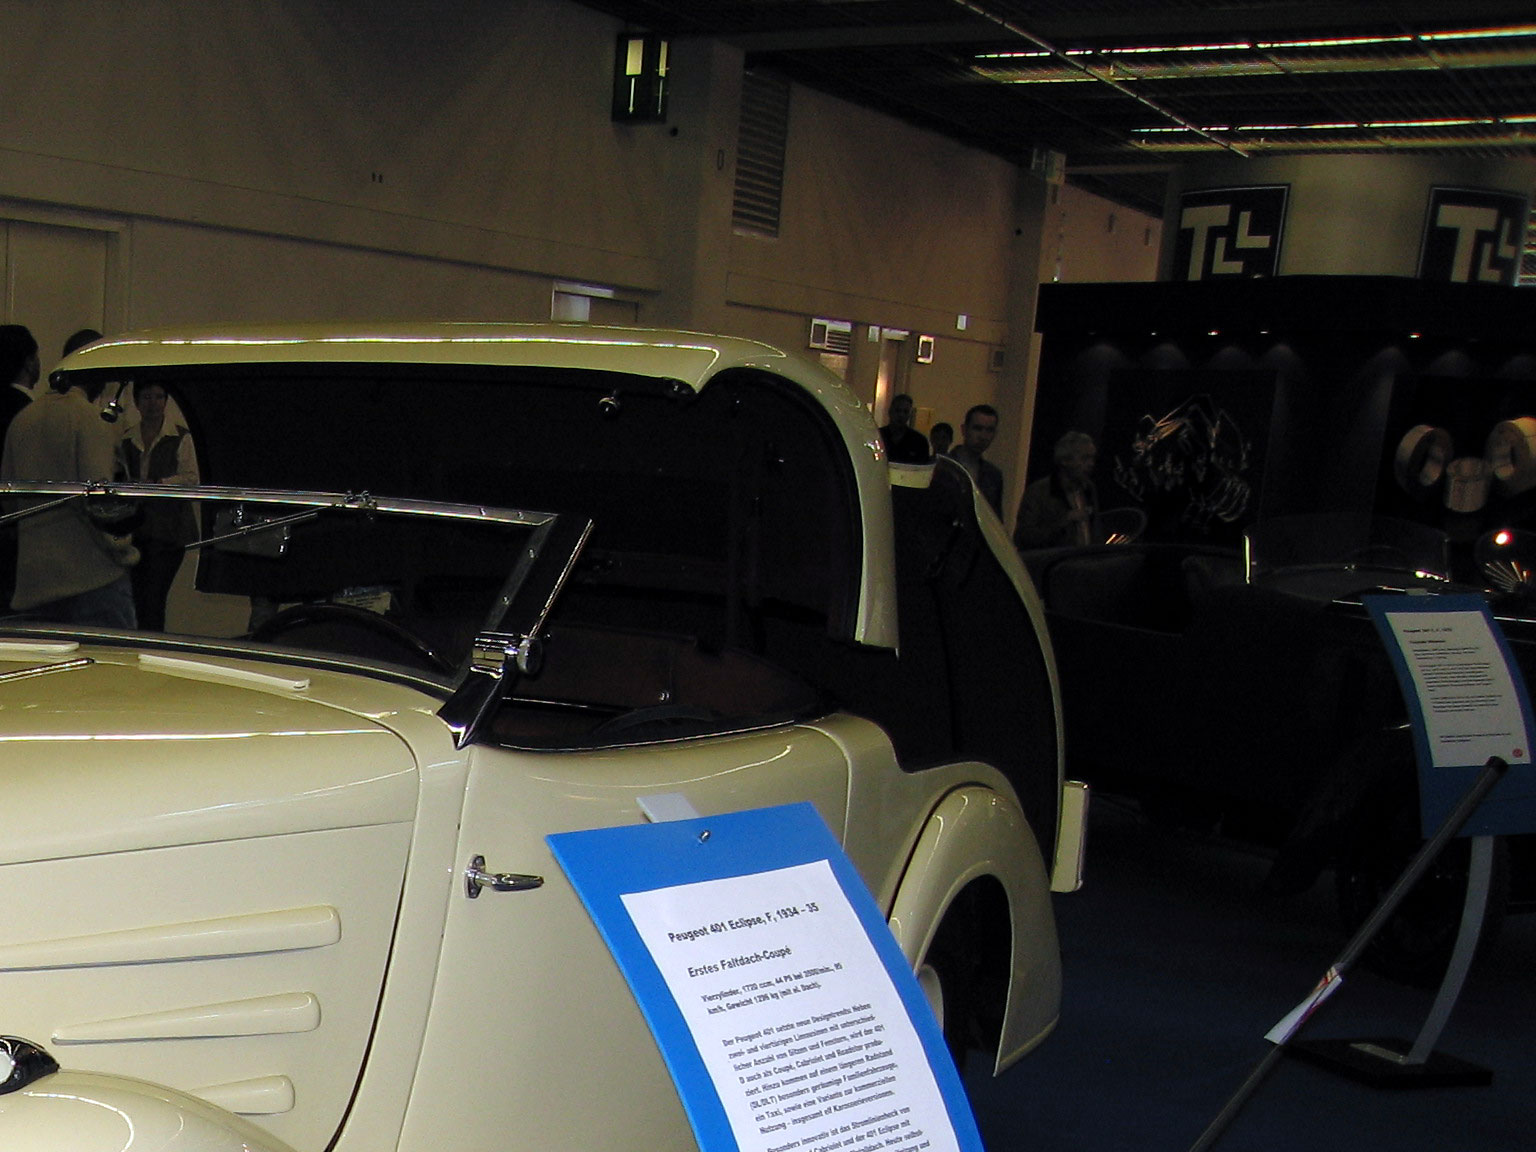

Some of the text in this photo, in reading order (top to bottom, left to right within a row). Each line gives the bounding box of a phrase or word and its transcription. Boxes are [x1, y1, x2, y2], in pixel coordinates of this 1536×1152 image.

[668, 926, 710, 942] Peugeot
[710, 922, 728, 933] 401
[728, 917, 767, 930] Eclipse,
[765, 912, 777, 922] F,
[777, 907, 800, 919] 1934
[806, 902, 819, 913] 35
[688, 946, 792, 978] Erstes Faltdach-Coupé
